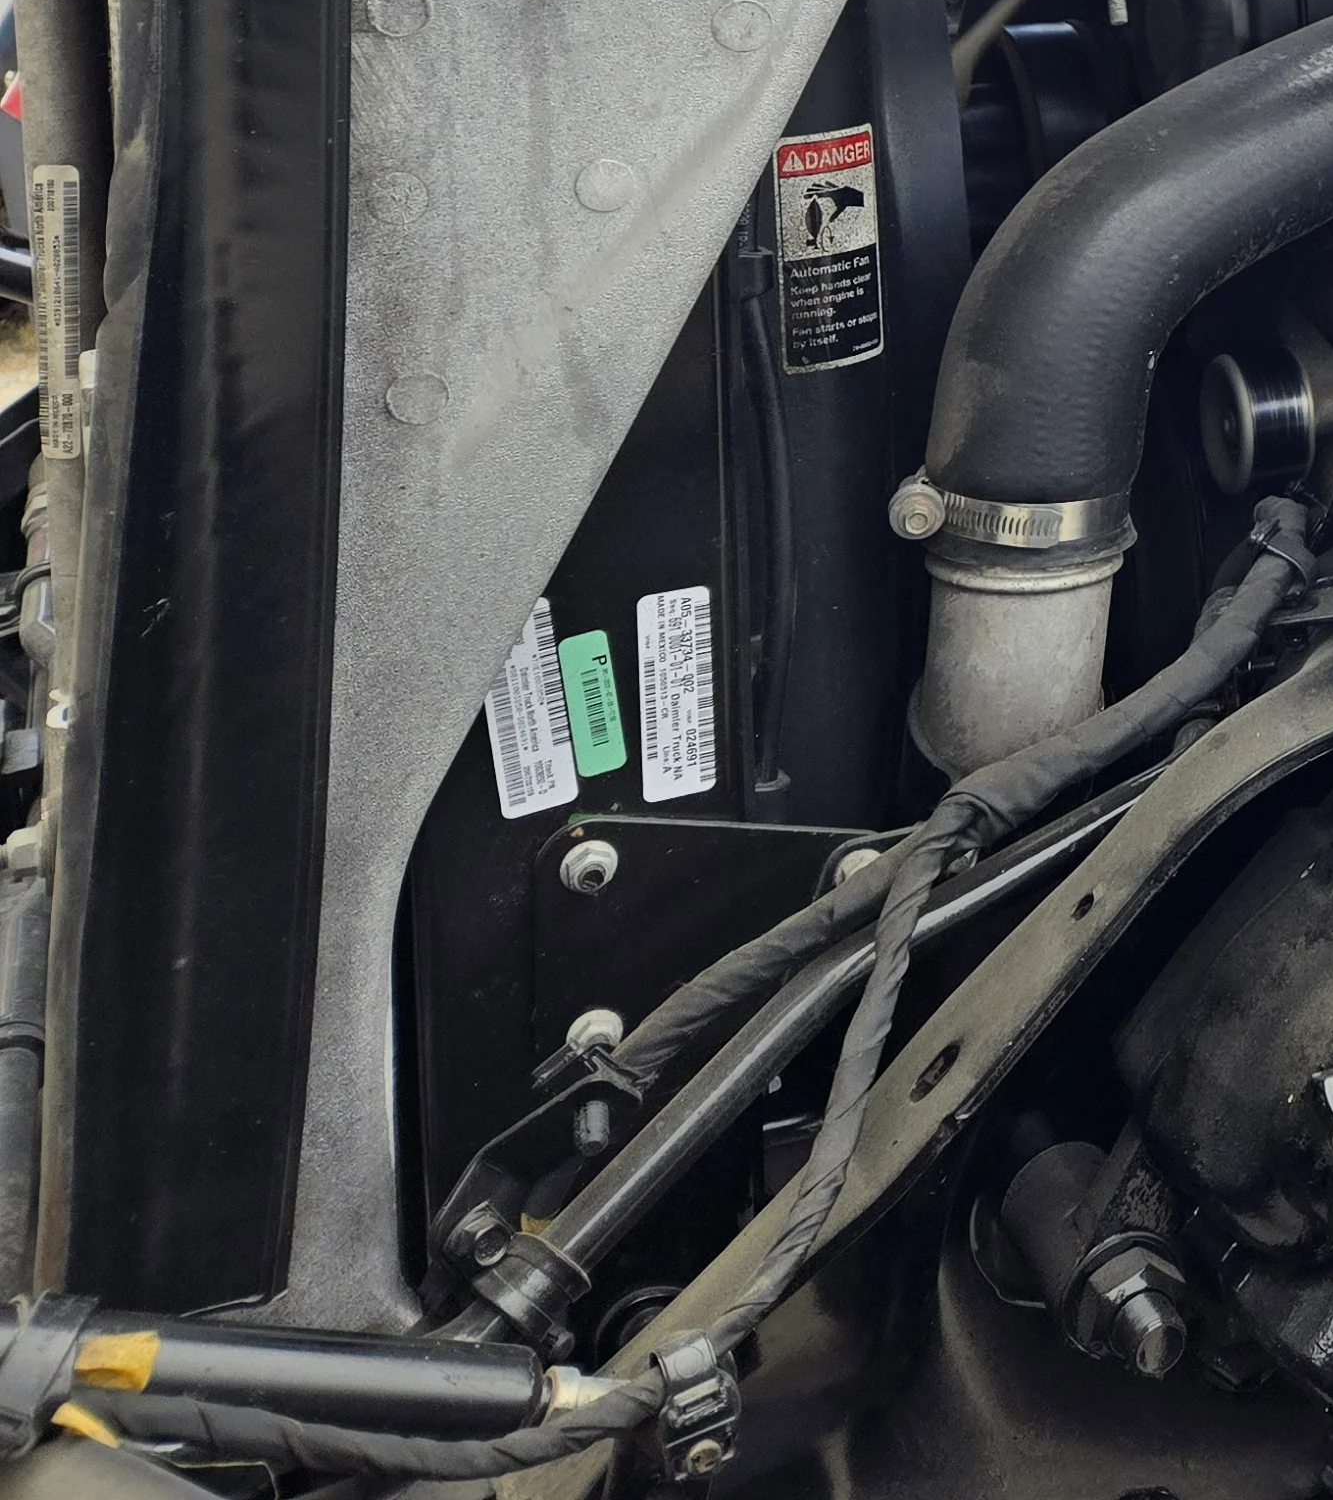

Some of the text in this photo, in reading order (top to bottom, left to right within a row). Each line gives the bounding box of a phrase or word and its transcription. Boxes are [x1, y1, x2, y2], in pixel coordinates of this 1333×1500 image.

[805, 140, 870, 169] DANGER
[34, 183, 44, 213] America
[35, 215, 45, 235] North
[790, 256, 870, 278] Automatic Fan
[791, 272, 871, 295] Keep hands clear
[790, 287, 864, 307] when engine is
[792, 307, 836, 320] running.
[792, 312, 877, 336] Fan starts or stops
[793, 334, 838, 350] by itself.
[657, 595, 665, 618] MADE
[658, 621, 665, 630] IN
[668, 617, 682, 631] 691
[680, 597, 695, 694] A05-33734-002
[592, 654, 607, 666] P
[523, 692, 534, 709] Truck
[526, 710, 537, 730] North
[671, 694, 681, 731] Daimler
[529, 727, 539, 753] America
[672, 734, 682, 763] Truck
[686, 728, 698, 767] 024691
[673, 765, 683, 781] NA
